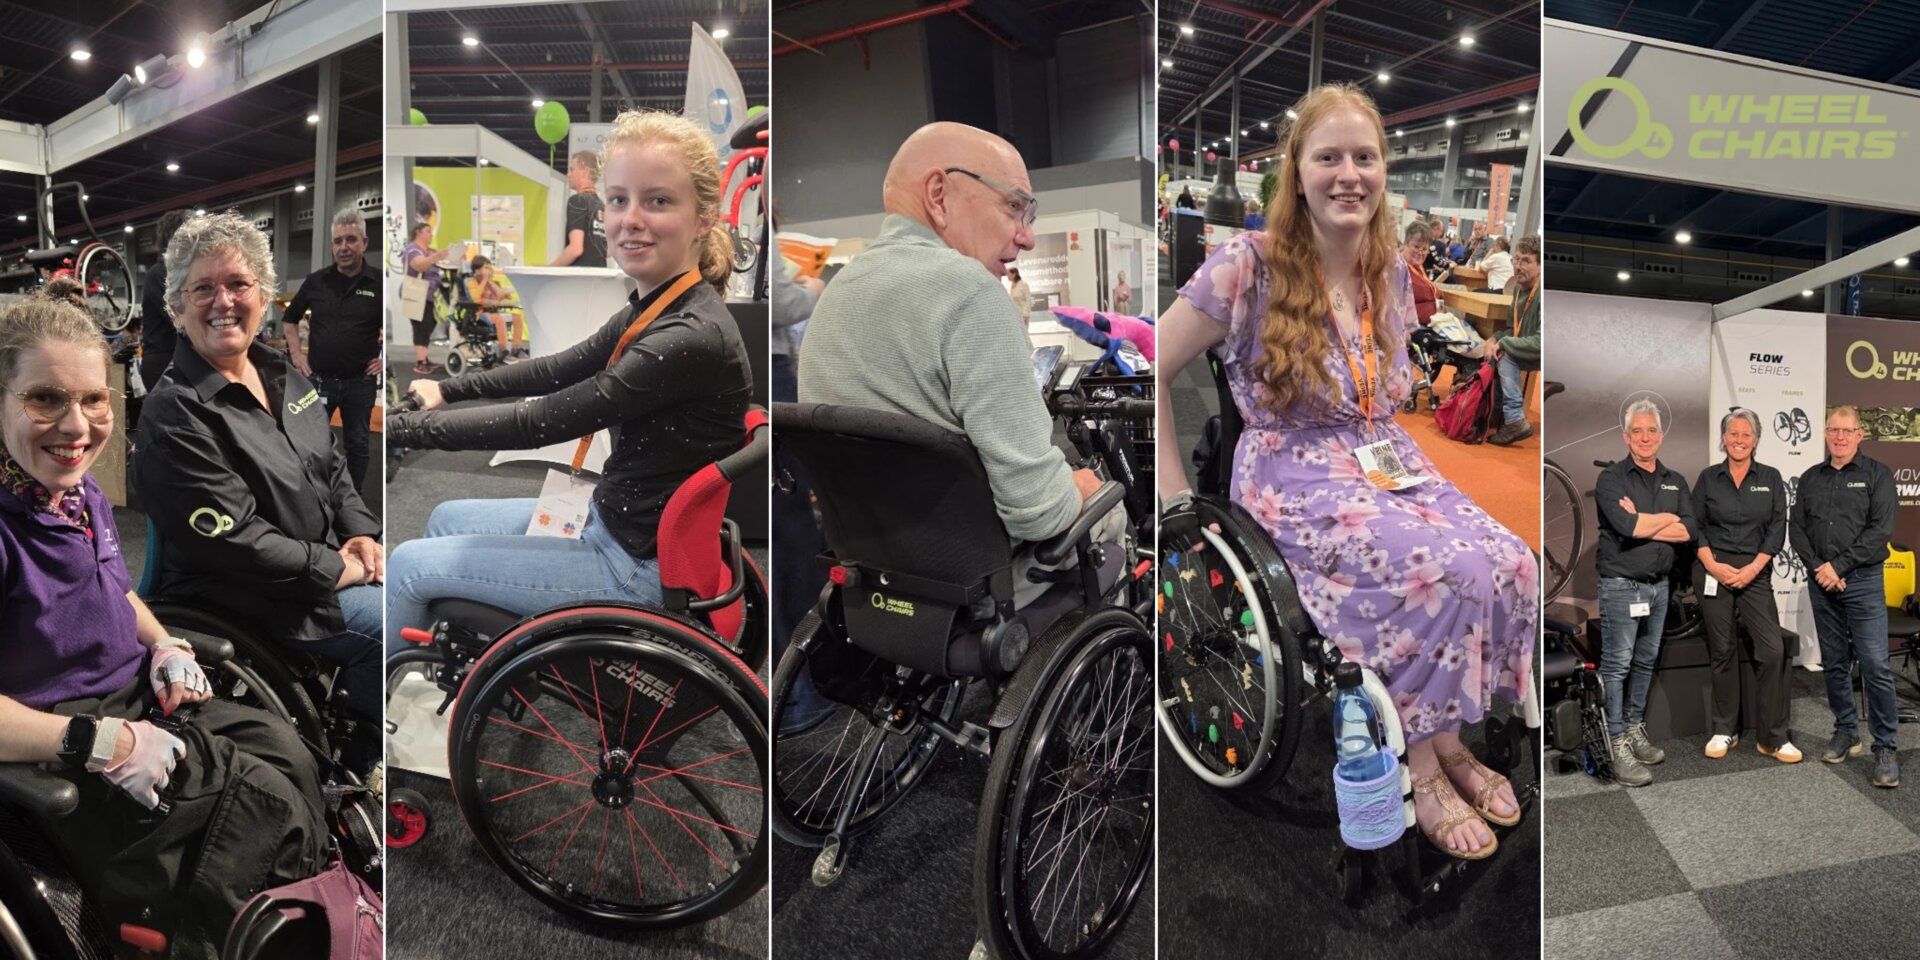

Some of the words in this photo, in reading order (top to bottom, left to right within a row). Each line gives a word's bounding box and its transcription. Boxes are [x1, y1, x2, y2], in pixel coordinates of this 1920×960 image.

[1749, 352, 1783, 364] FLOW
[1750, 364, 1791, 376] SERIES
[605, 665, 677, 709] CHAIRS
[611, 657, 676, 698] WHEEL
